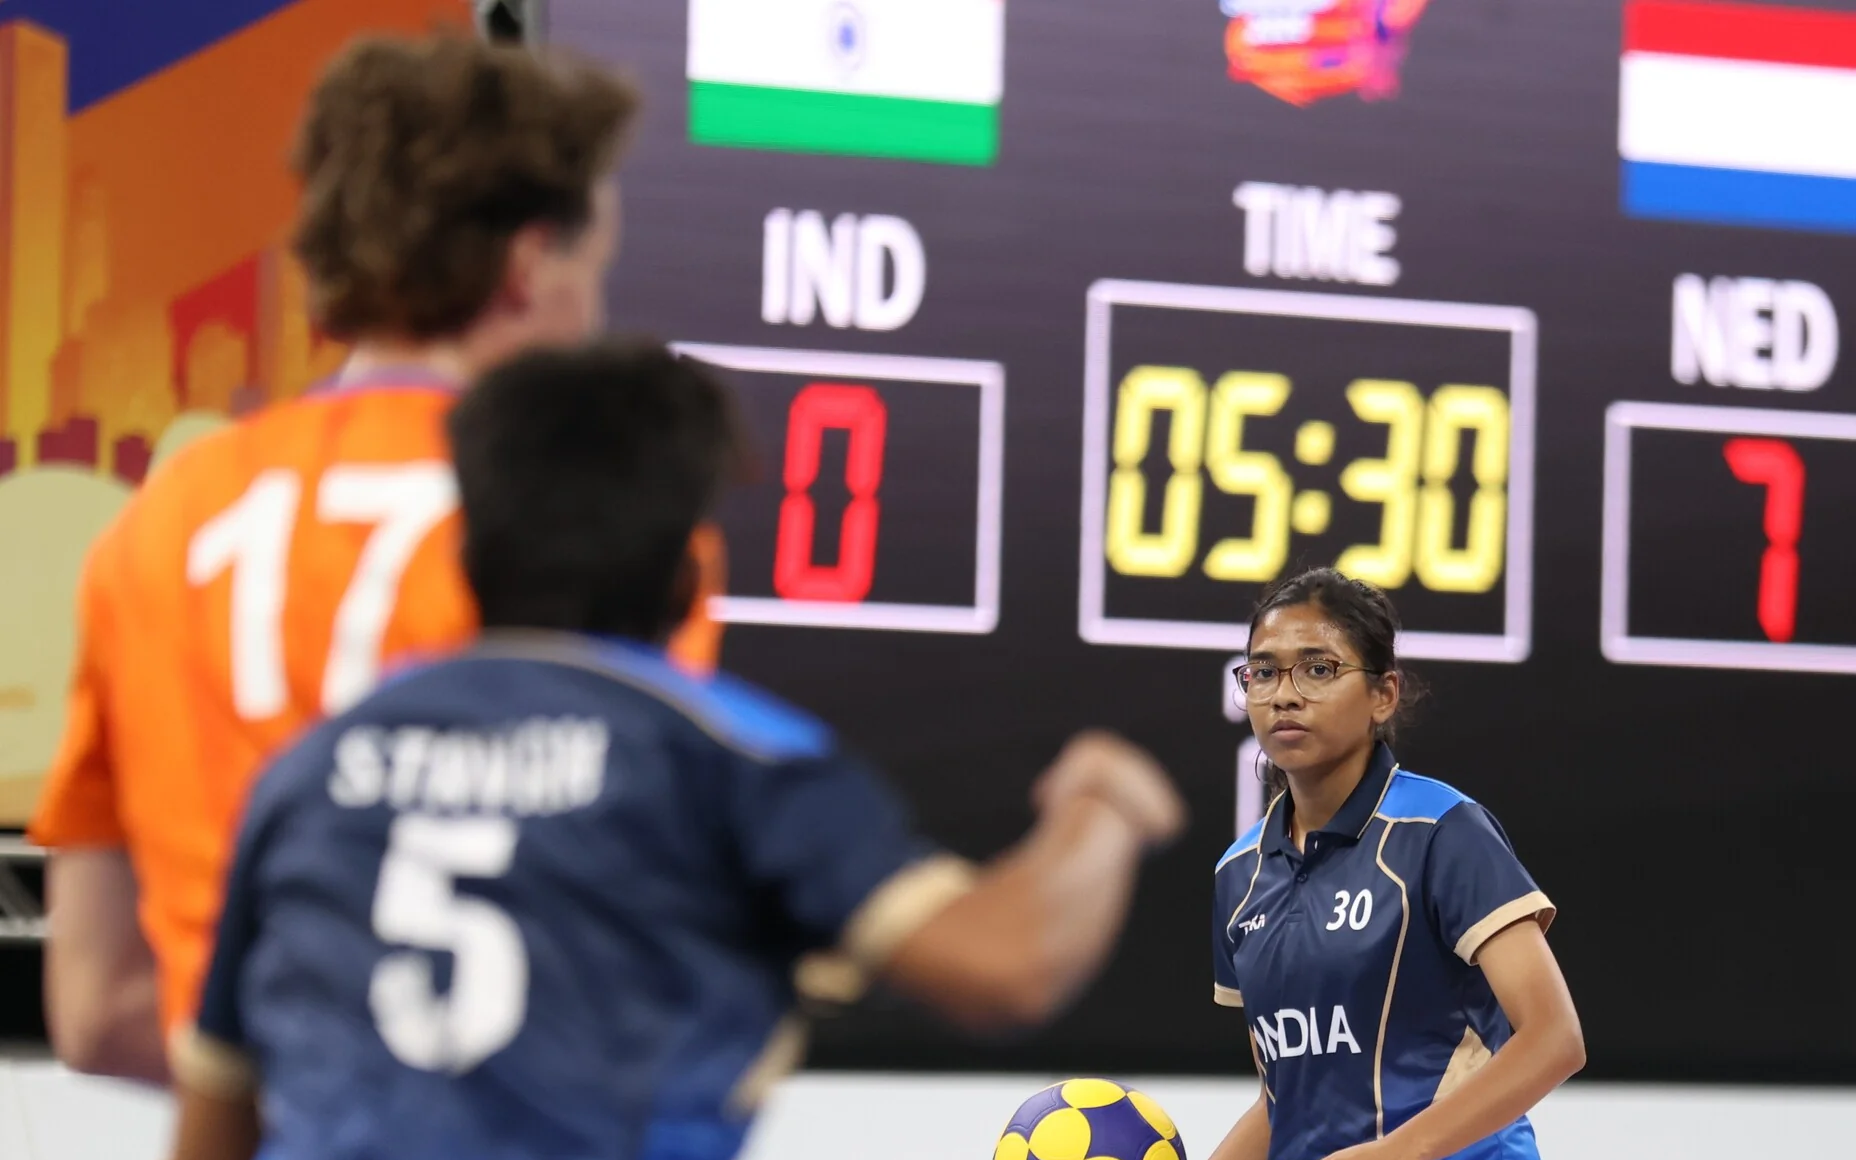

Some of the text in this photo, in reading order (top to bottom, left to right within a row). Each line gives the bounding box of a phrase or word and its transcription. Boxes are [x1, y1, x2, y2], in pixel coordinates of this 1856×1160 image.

[761, 209, 926, 331] IND
[1233, 182, 1401, 286] TIME
[1671, 274, 1839, 391] NED
[773, 383, 887, 604] 0
[1106, 365, 1509, 593] 05:30
[1722, 438, 1805, 643] 7
[187, 460, 458, 720] 17
[369, 813, 526, 1074] 5
[1325, 888, 1373, 931] 30
